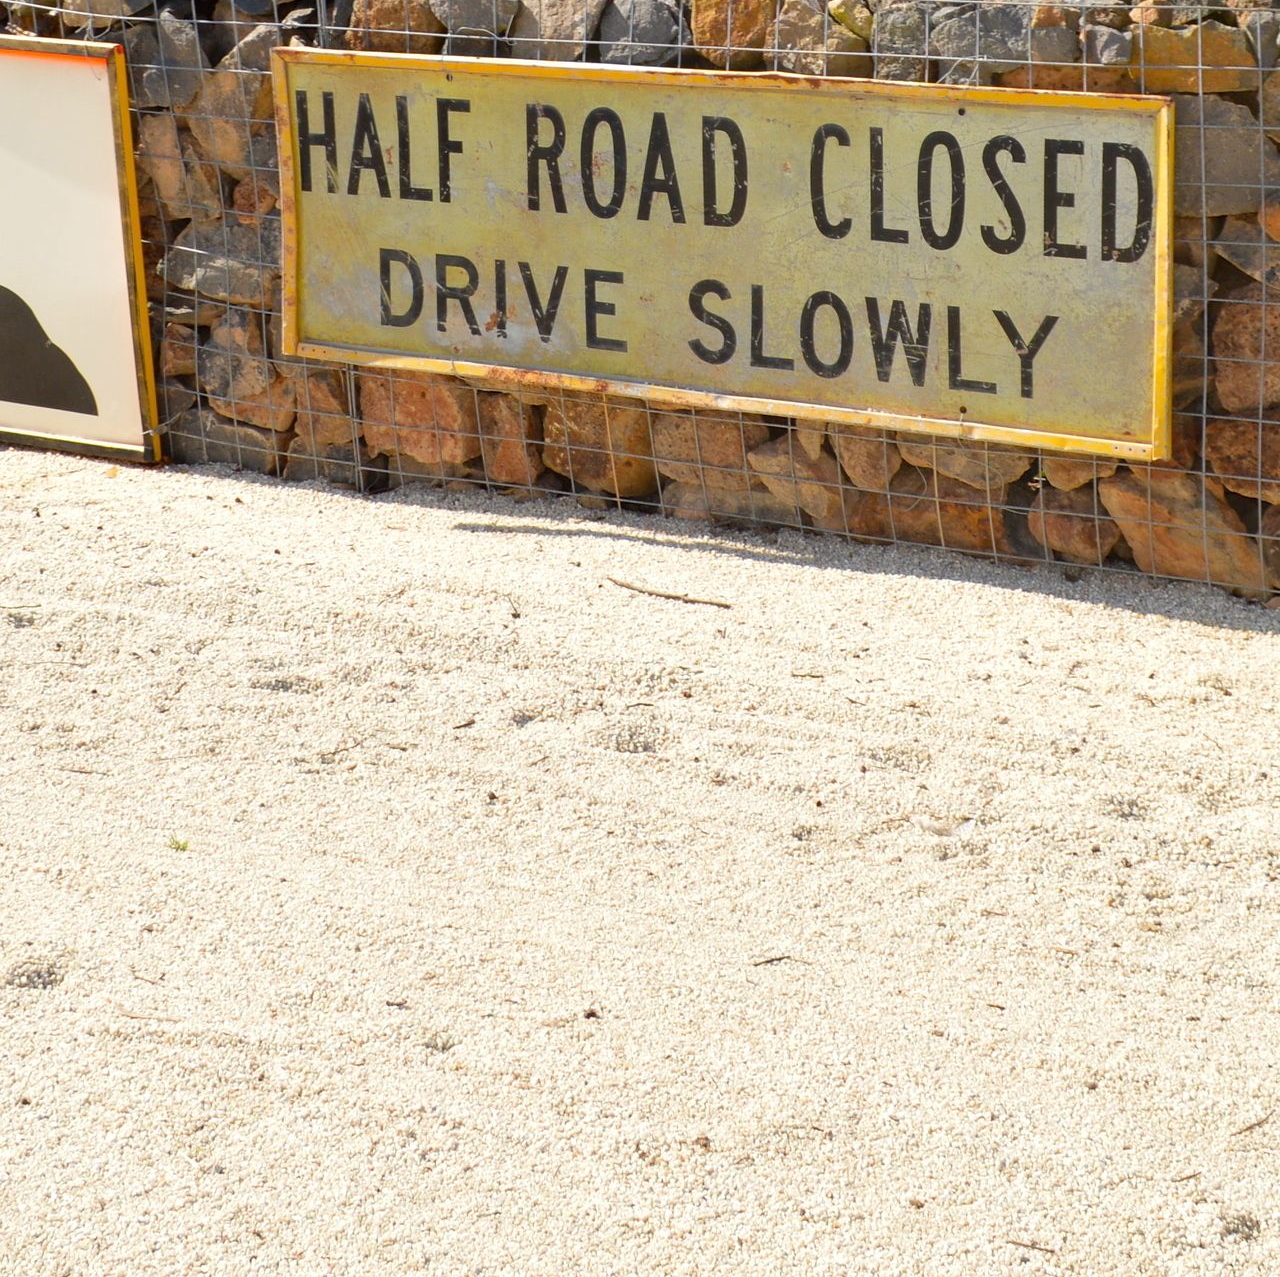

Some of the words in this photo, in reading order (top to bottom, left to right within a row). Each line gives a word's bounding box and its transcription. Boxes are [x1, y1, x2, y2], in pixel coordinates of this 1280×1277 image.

[295, 90, 471, 203] HALF
[526, 103, 748, 227] ROAD
[810, 123, 1152, 263] CLOSED
[379, 248, 628, 352] DRIVE
[687, 279, 1059, 398] SLOWLY
